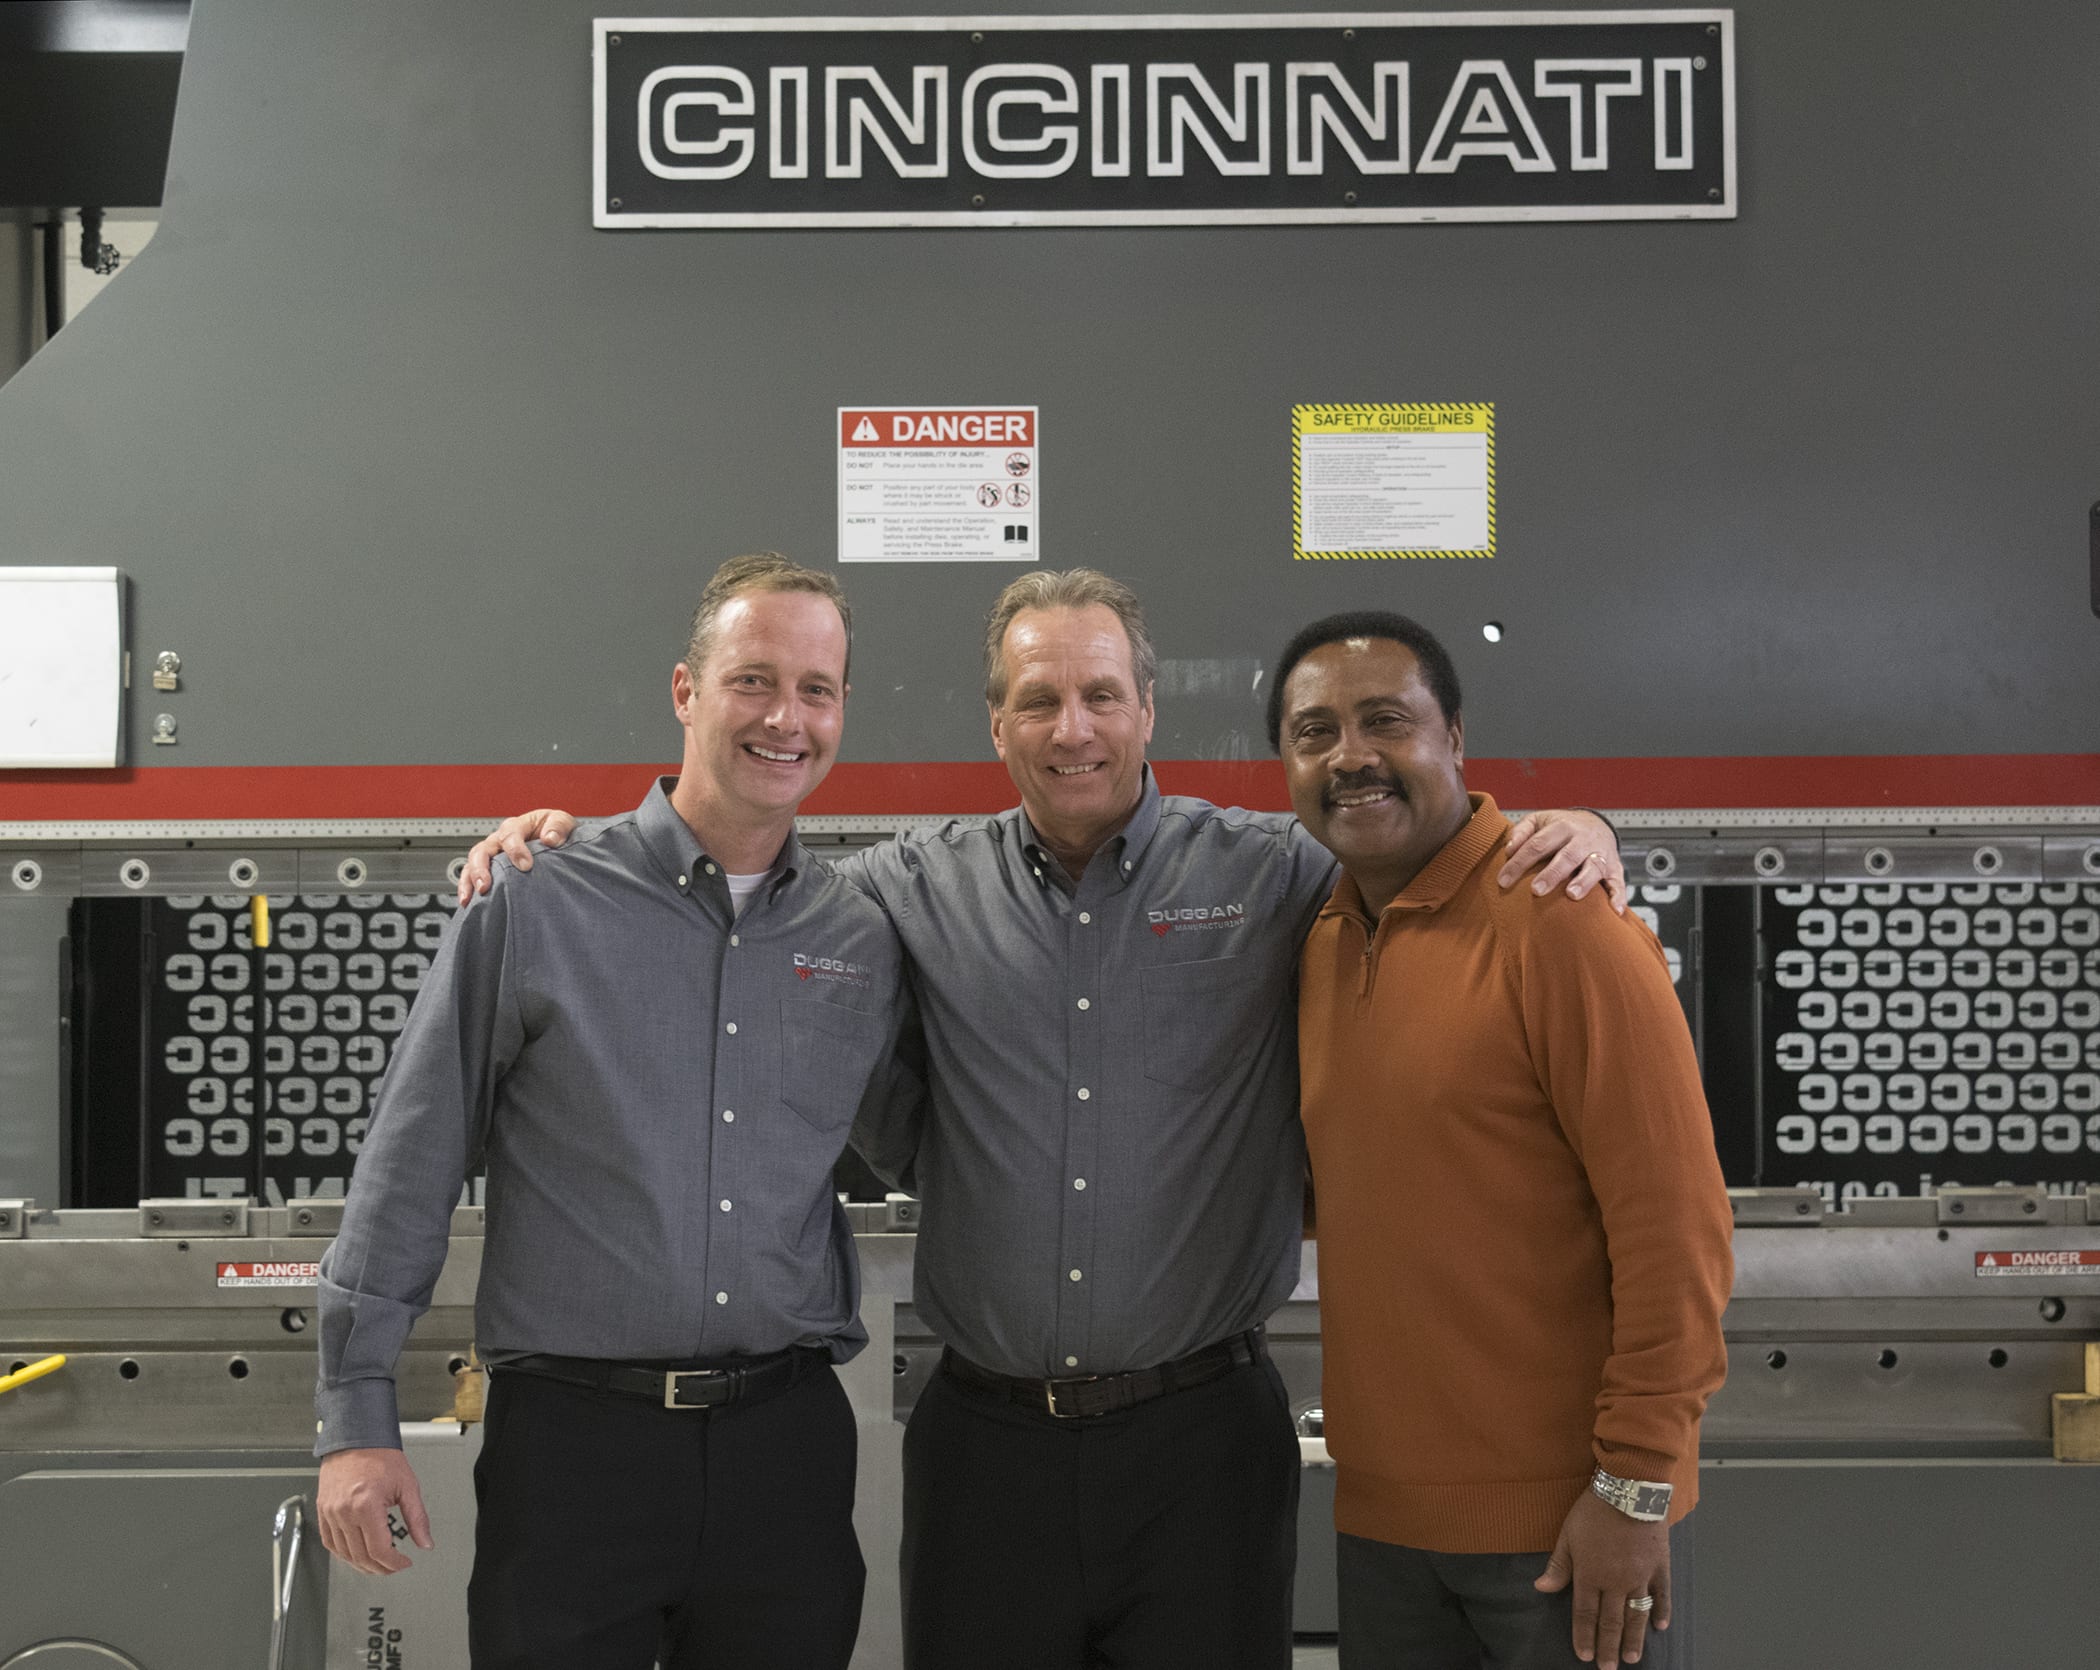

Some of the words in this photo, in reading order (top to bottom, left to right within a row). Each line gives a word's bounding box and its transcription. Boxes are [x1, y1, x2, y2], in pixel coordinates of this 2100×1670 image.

[638, 57, 1694, 180] CINCINNATI
[1313, 413, 1374, 426] SAFETY
[1378, 412, 1475, 426] GUIDELINES
[893, 415, 1028, 442] DANGER
[1147, 903, 1244, 923] DUGGAN
[2012, 1252, 2081, 1265] DANGER
[253, 1263, 320, 1276] DANGER
